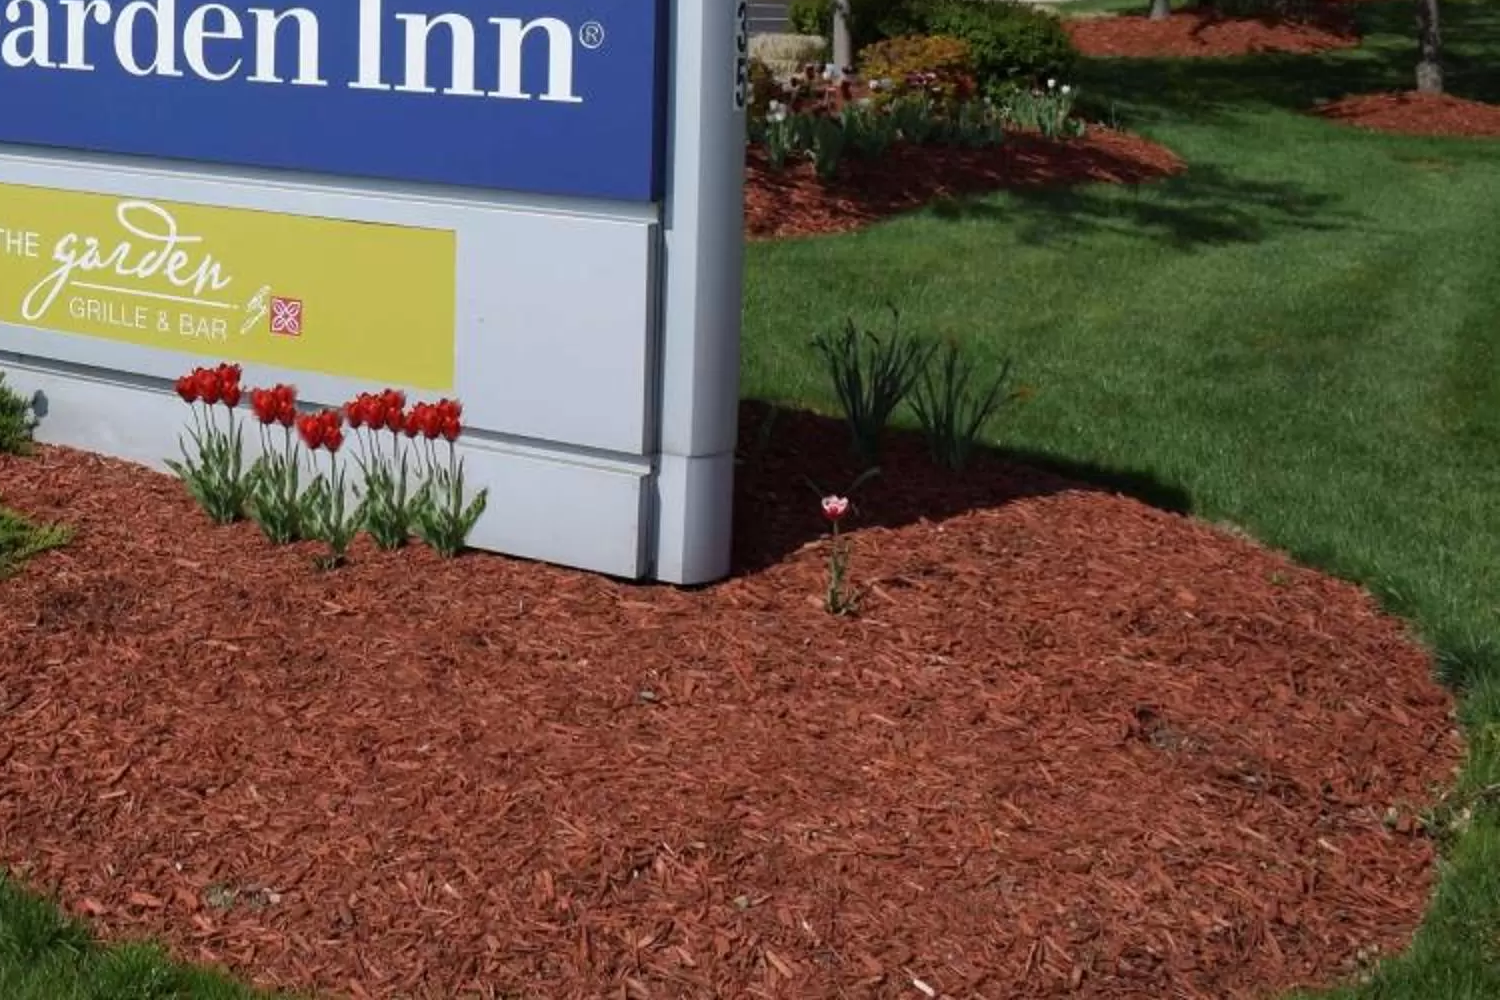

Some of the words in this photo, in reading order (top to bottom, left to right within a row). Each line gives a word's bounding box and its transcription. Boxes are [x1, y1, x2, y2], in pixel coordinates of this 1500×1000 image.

[20, 201, 232, 321] garden
[68, 295, 149, 330] GRILLE
[156, 310, 171, 332] &
[179, 313, 228, 341] BAR
